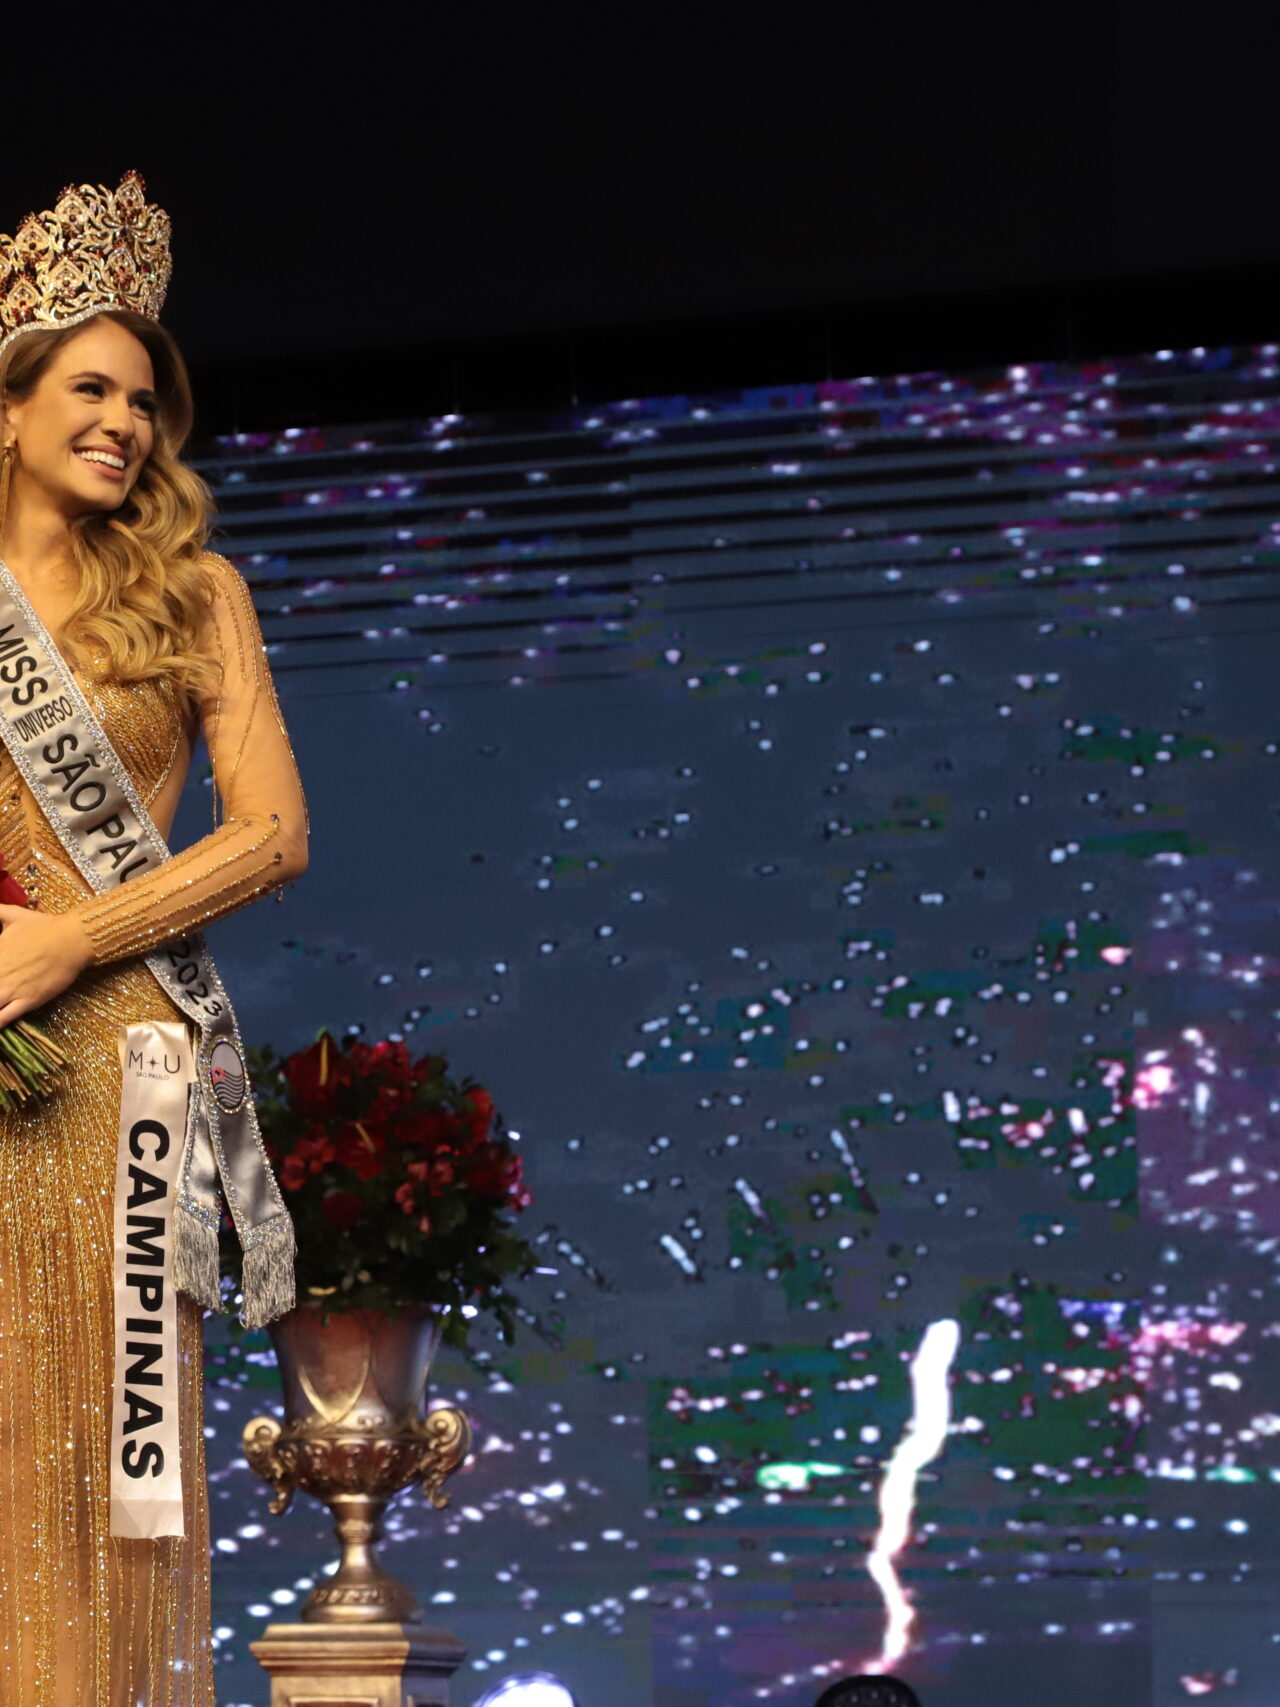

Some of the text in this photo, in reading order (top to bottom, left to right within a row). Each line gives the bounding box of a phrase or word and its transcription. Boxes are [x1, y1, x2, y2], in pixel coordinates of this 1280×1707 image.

[13, 695, 73, 743] UNIVERSO
[42, 733, 107, 812] SÃO
[167, 940, 223, 1017] 2023
[121, 1119, 170, 1479] CAMPINAS
